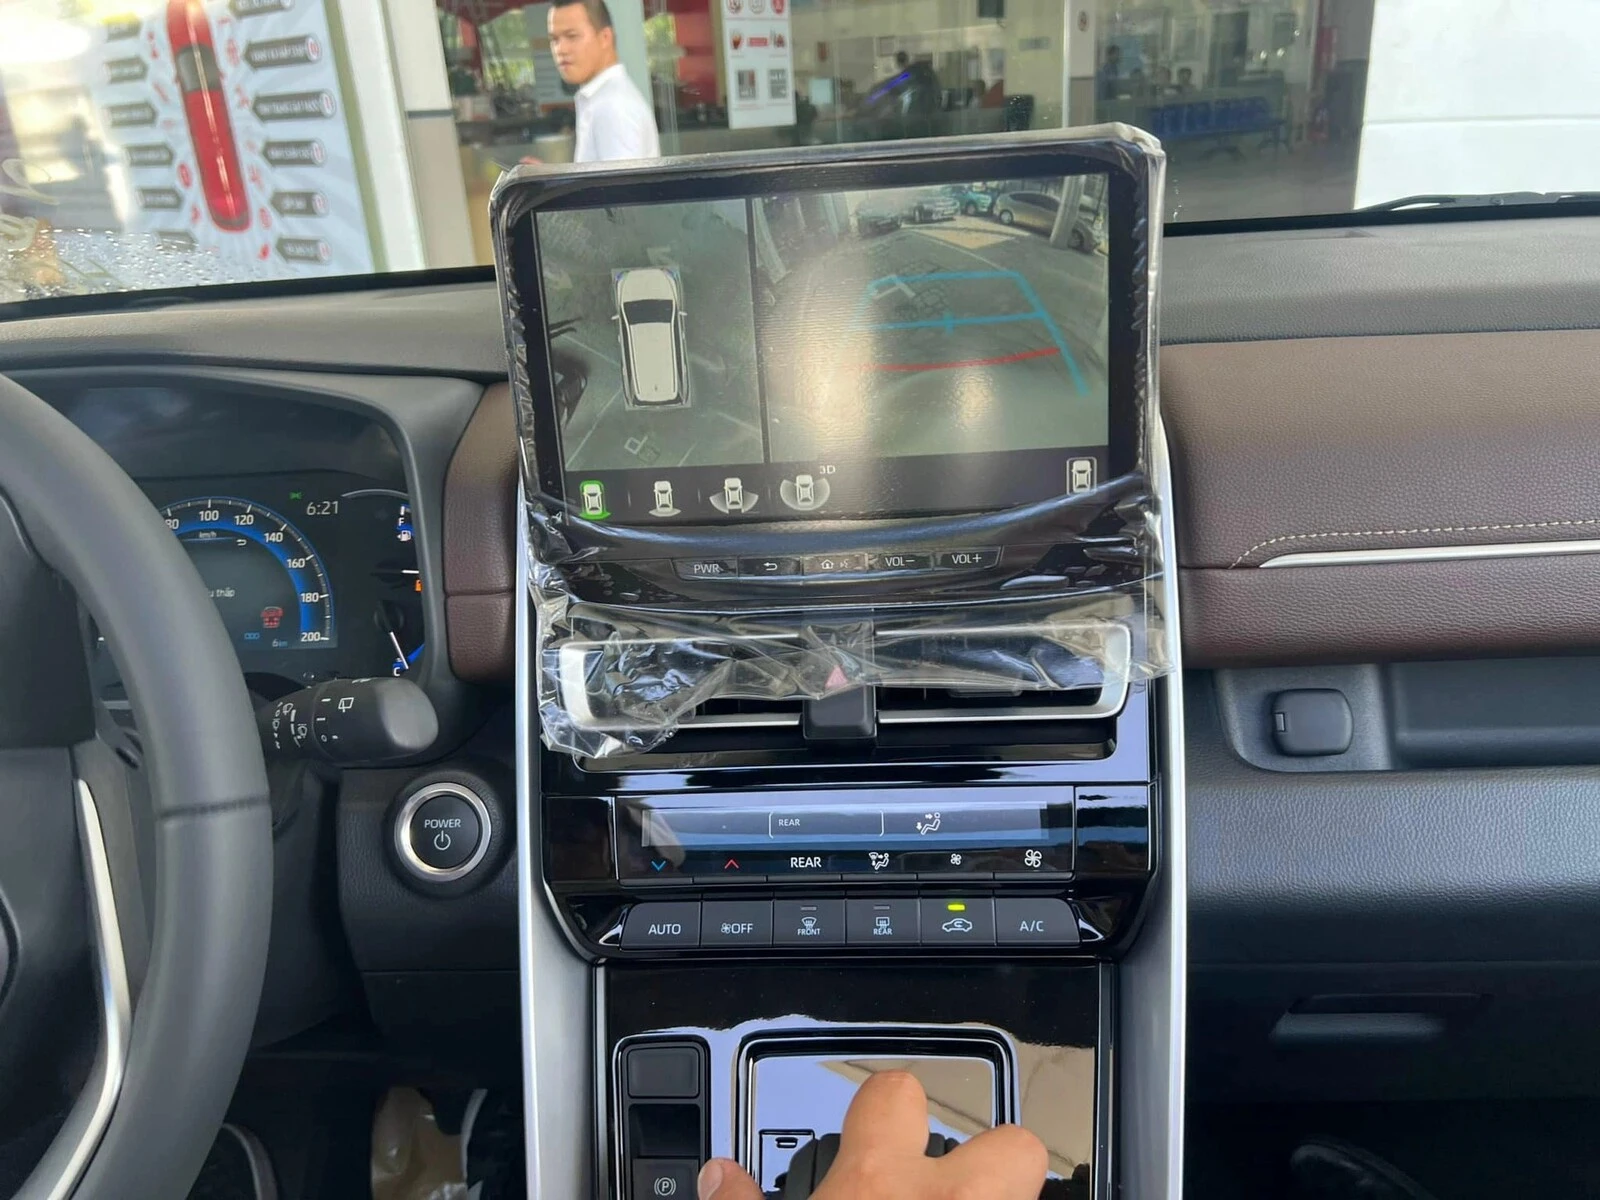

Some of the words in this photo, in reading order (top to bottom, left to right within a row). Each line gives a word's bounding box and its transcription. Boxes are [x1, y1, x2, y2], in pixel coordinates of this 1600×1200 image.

[819, 464, 836, 475] 3D
[306, 500, 340, 516] 6:21
[199, 510, 220, 522] 100
[234, 514, 254, 526] 120
[398, 517, 405, 527] F
[263, 532, 284, 543] 140
[286, 558, 306, 569] 160
[951, 553, 982, 564] VOL+
[693, 563, 724, 574] PWR
[300, 592, 320, 603] 180
[300, 632, 321, 643] 200
[393, 666, 401, 677] C
[424, 818, 462, 829] POWER
[778, 818, 801, 827] REAR
[790, 856, 822, 868] REAR
[648, 923, 682, 935] AUTO
[731, 923, 754, 934] OFF
[1019, 920, 1045, 932] A/C
[797, 928, 821, 936] FRONT
